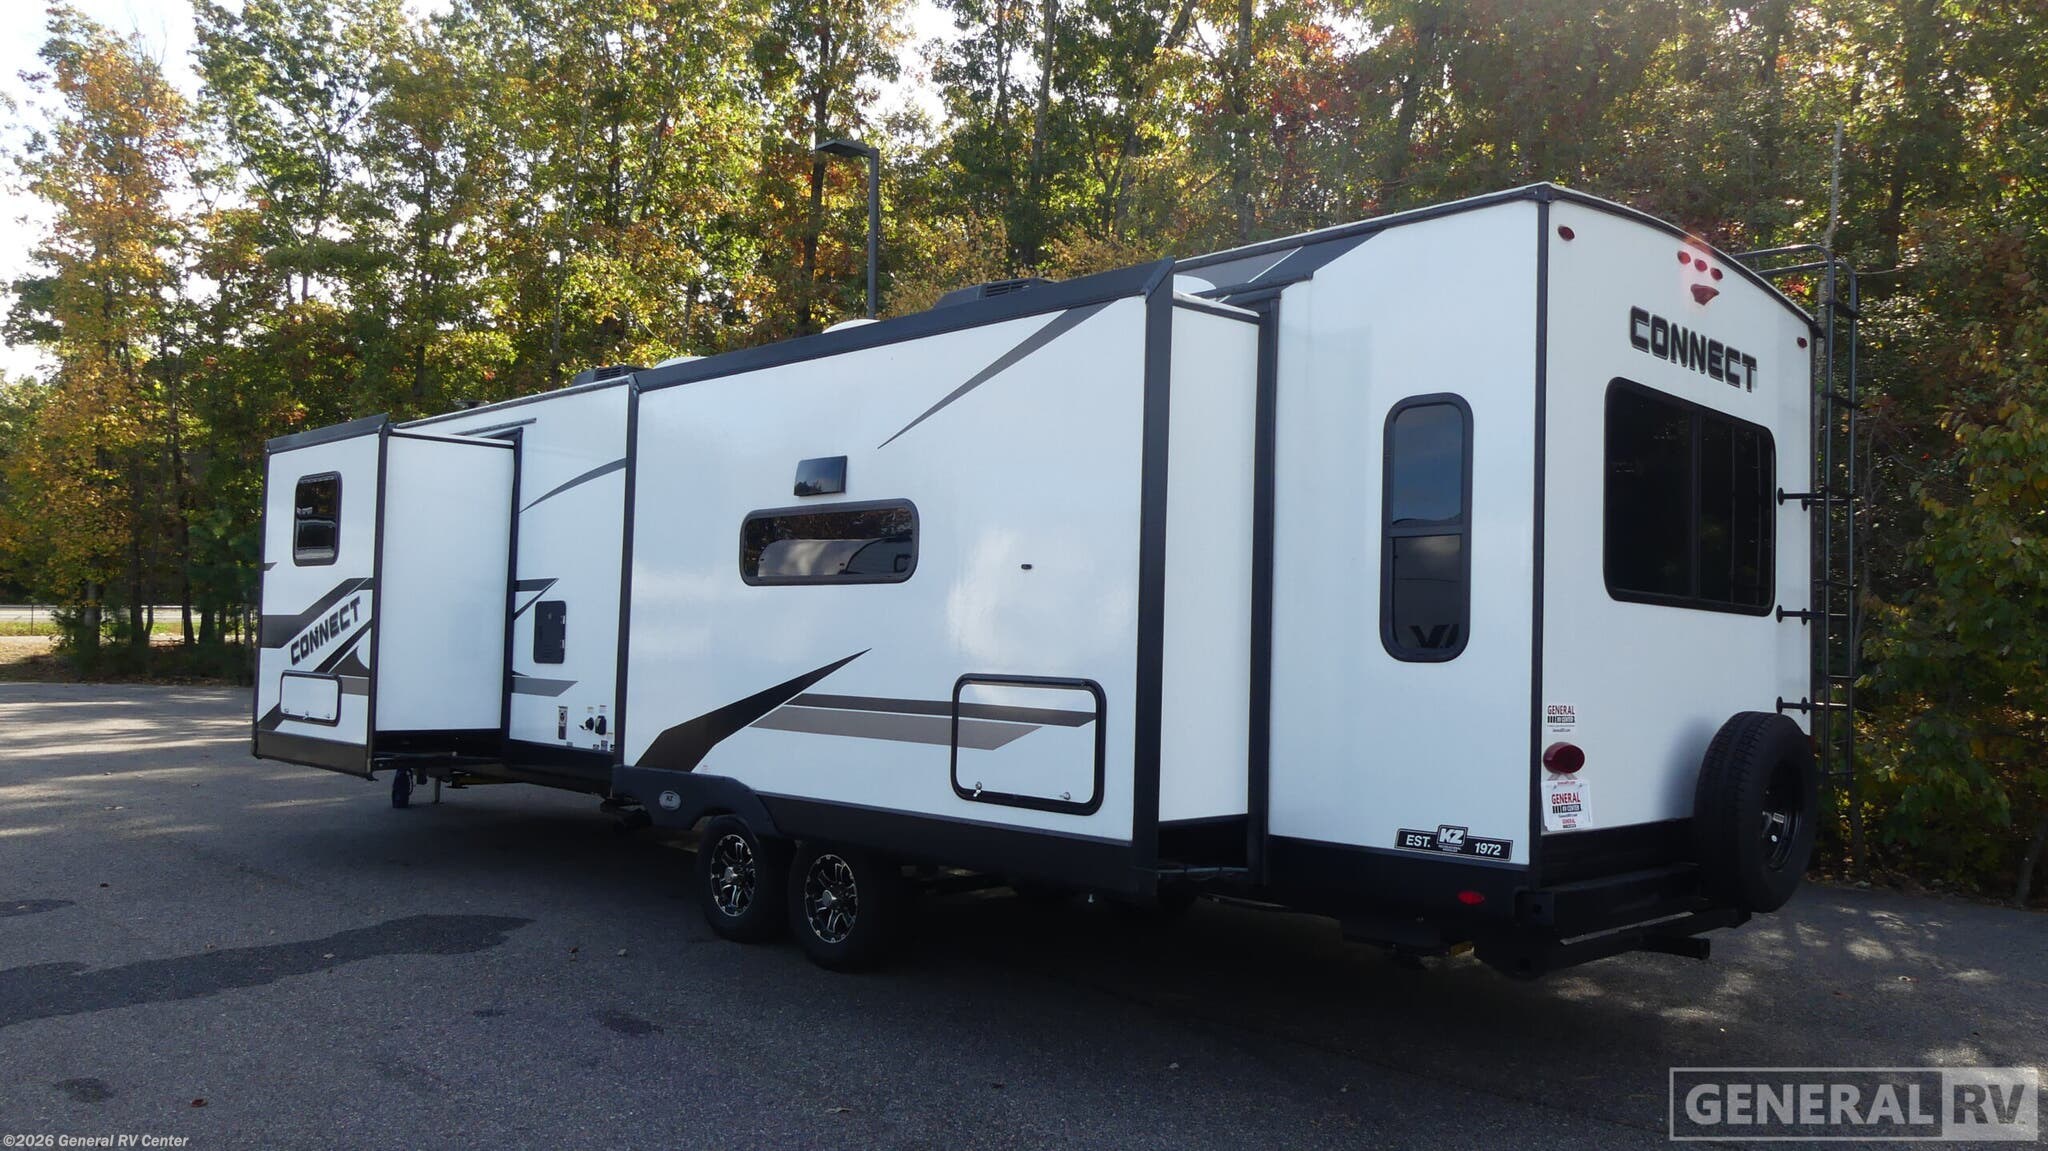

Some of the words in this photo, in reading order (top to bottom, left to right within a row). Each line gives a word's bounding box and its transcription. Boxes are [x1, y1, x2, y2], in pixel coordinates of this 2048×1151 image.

[1630, 305, 1757, 393] CONNECT
[290, 596, 360, 666] CONNECT
[1547, 704, 1575, 715] GENERAL
[1552, 792, 1581, 805] GENERAL
[1405, 834, 1431, 848] EST.
[1474, 842, 1501, 856] 1972
[1439, 828, 1465, 844] KZ
